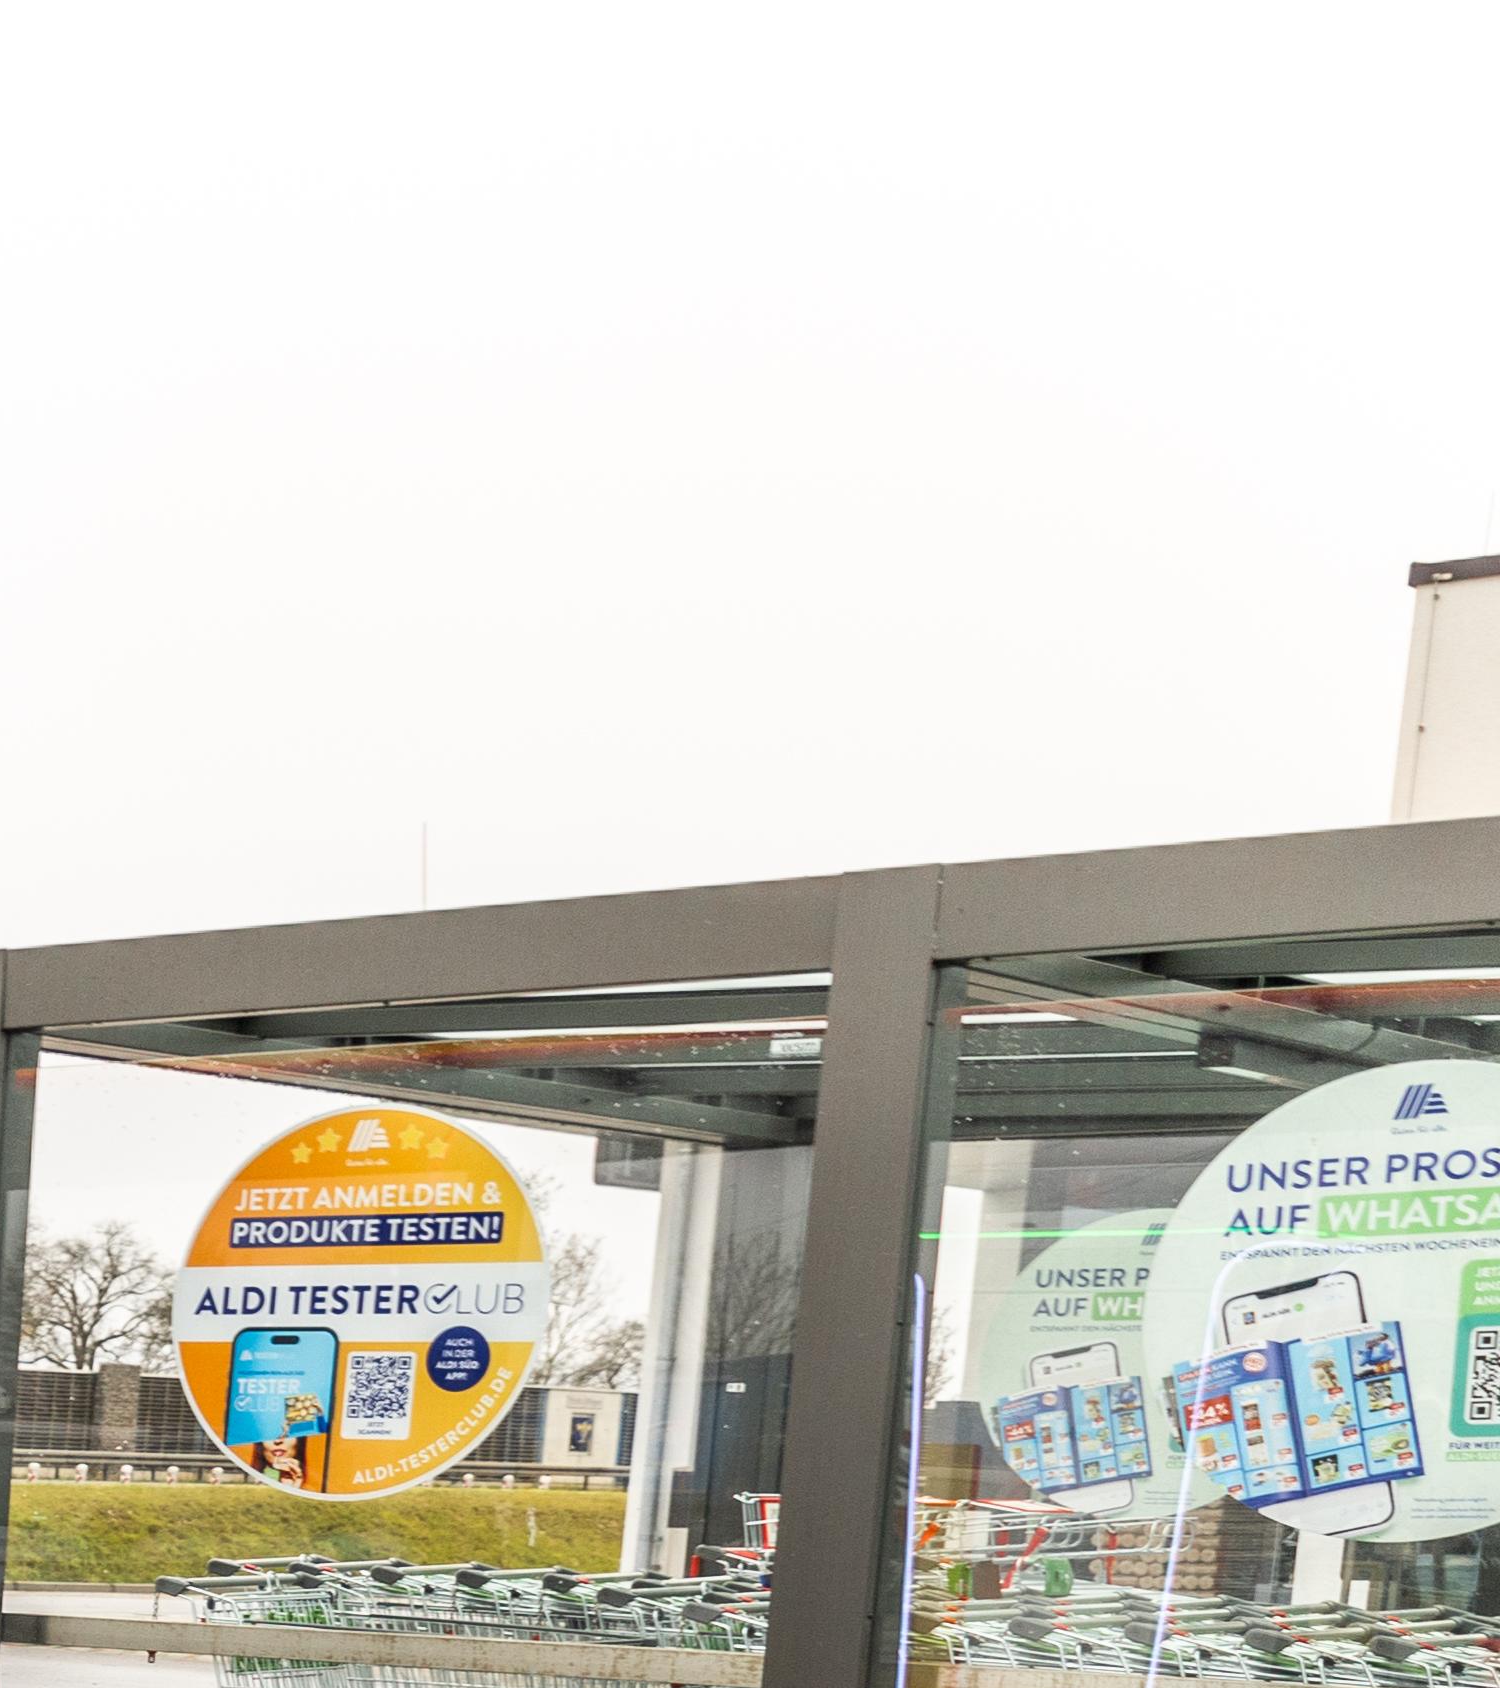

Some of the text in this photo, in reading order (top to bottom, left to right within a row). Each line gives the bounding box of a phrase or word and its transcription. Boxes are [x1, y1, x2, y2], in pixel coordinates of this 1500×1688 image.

[1226, 1147, 1500, 1193] UNSER PROS
[234, 1181, 502, 1212] JETZT ANMELDEN &
[232, 1215, 501, 1245] PRODUKTE TESTEN!
[1223, 1192, 1500, 1238] AUF WHATSA
[1035, 1267, 1127, 1288] UNSER
[193, 1285, 278, 1316] ALDI
[1032, 1297, 1090, 1318] AUF
[236, 1378, 301, 1394] TESTER
[352, 1366, 513, 1485] ALDI-TESTERCLUB.DE
